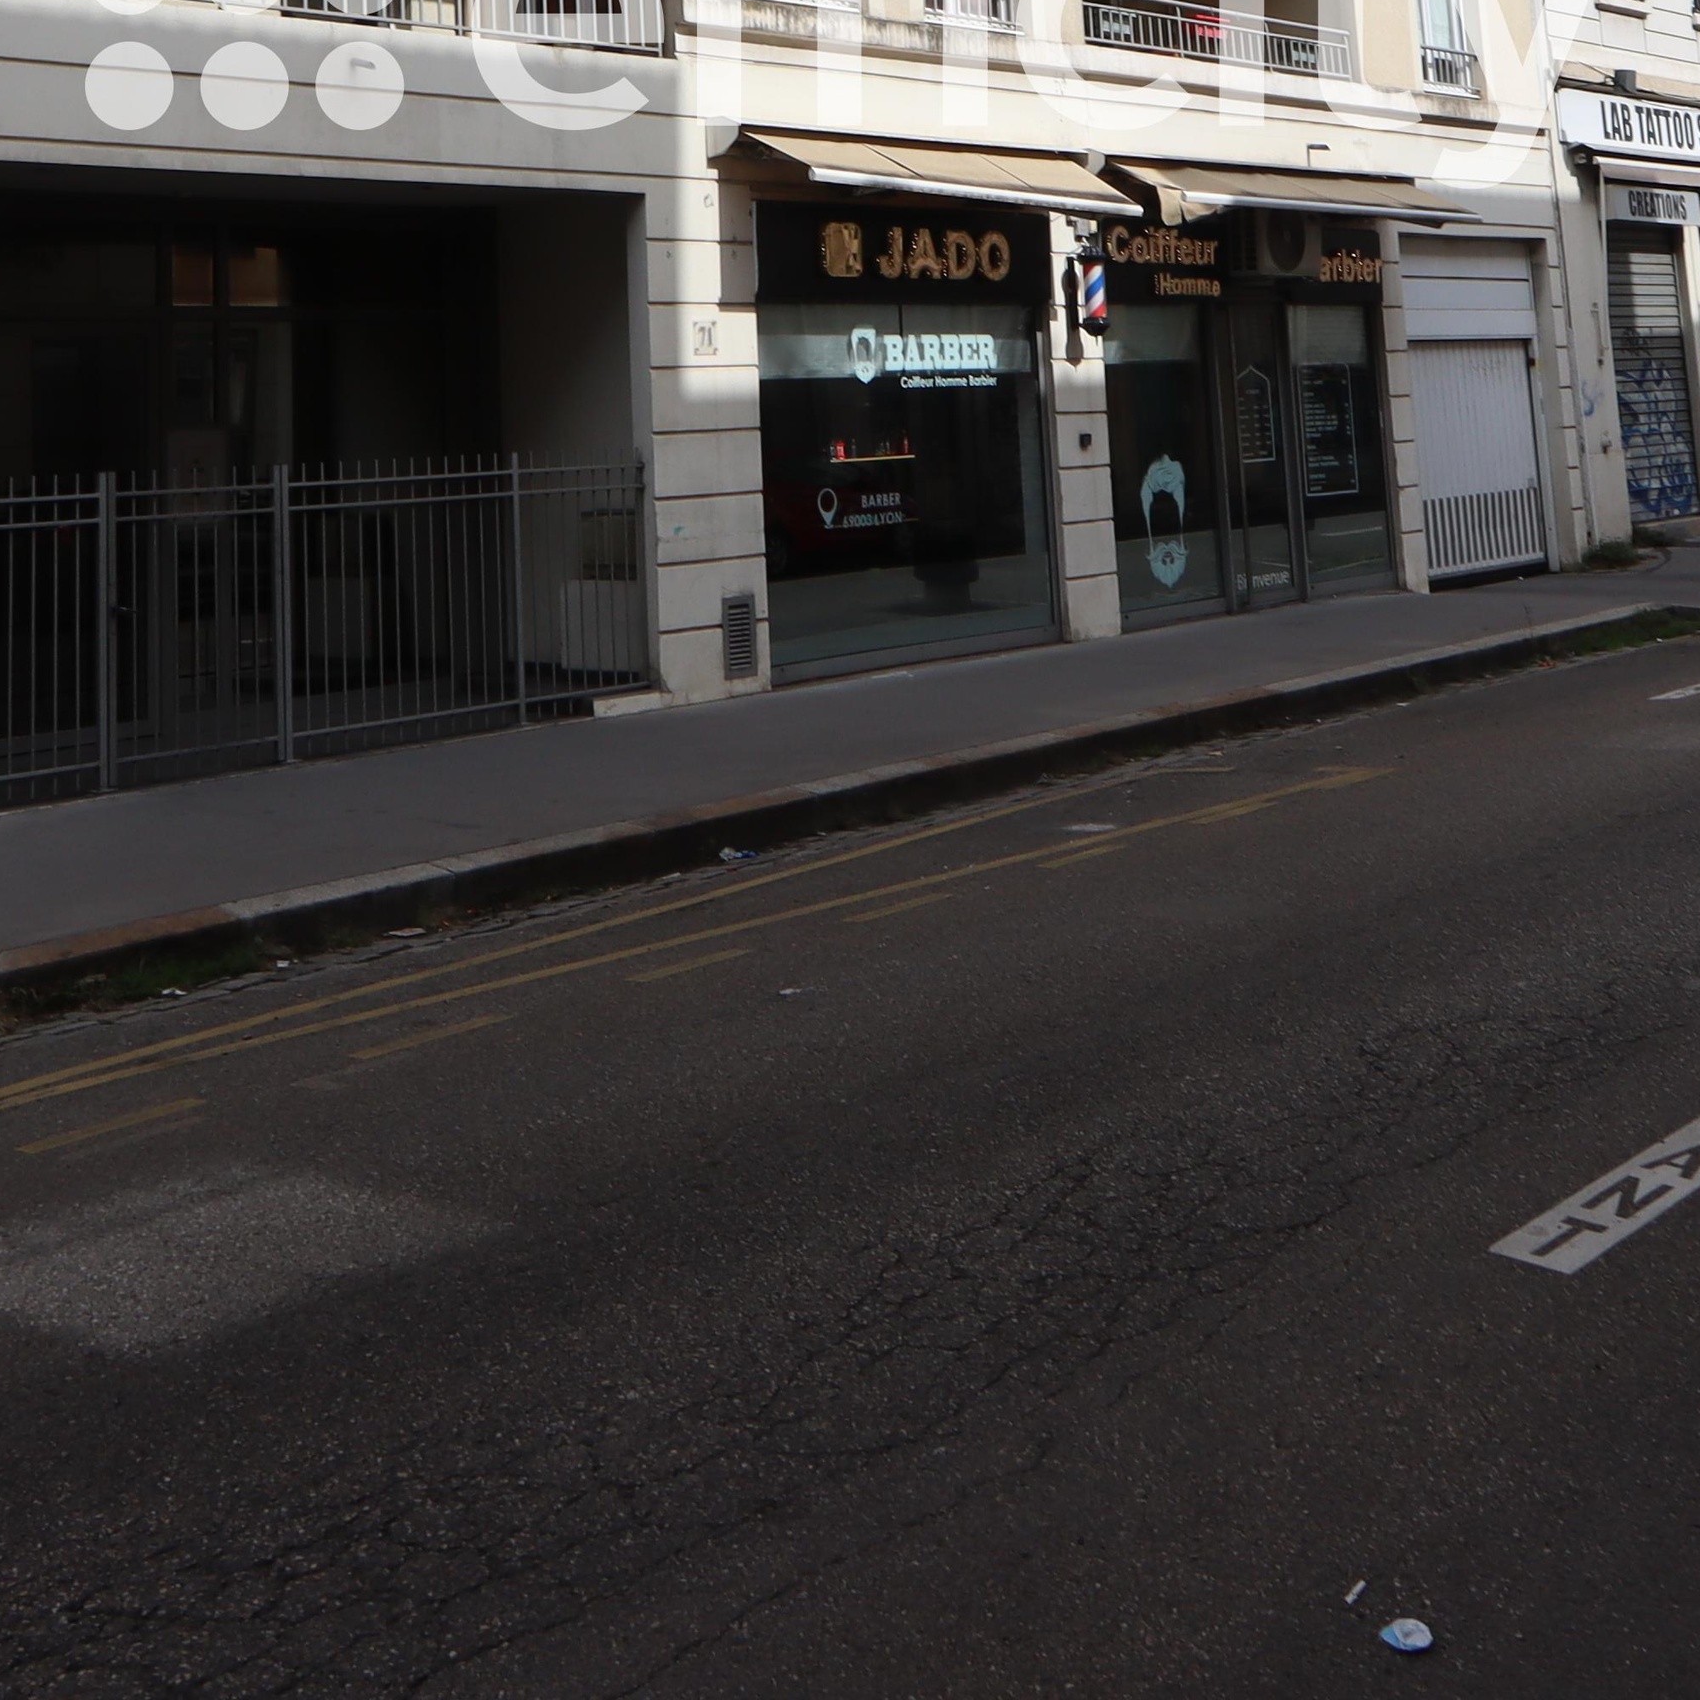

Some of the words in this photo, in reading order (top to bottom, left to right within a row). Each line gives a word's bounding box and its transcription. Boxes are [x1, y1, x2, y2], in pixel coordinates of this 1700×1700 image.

[1600, 101, 1633, 142] LAB
[1635, 105, 1696, 151] TATTOO
[1628, 189, 1688, 221] CREATIONS
[876, 226, 1011, 281] JADO
[1106, 224, 1218, 265] Coiffeur
[1318, 248, 1384, 284] arbier
[1157, 273, 1222, 298] Homme
[697, 326, 713, 348] 71
[882, 333, 998, 372] BARBER
[900, 375, 935, 389] Coiffeur
[935, 375, 968, 388] Homme
[968, 374, 998, 388] Barbier
[860, 492, 902, 508] BARBER
[873, 511, 903, 526] LYON
[1236, 570, 1291, 591] Binvenue
